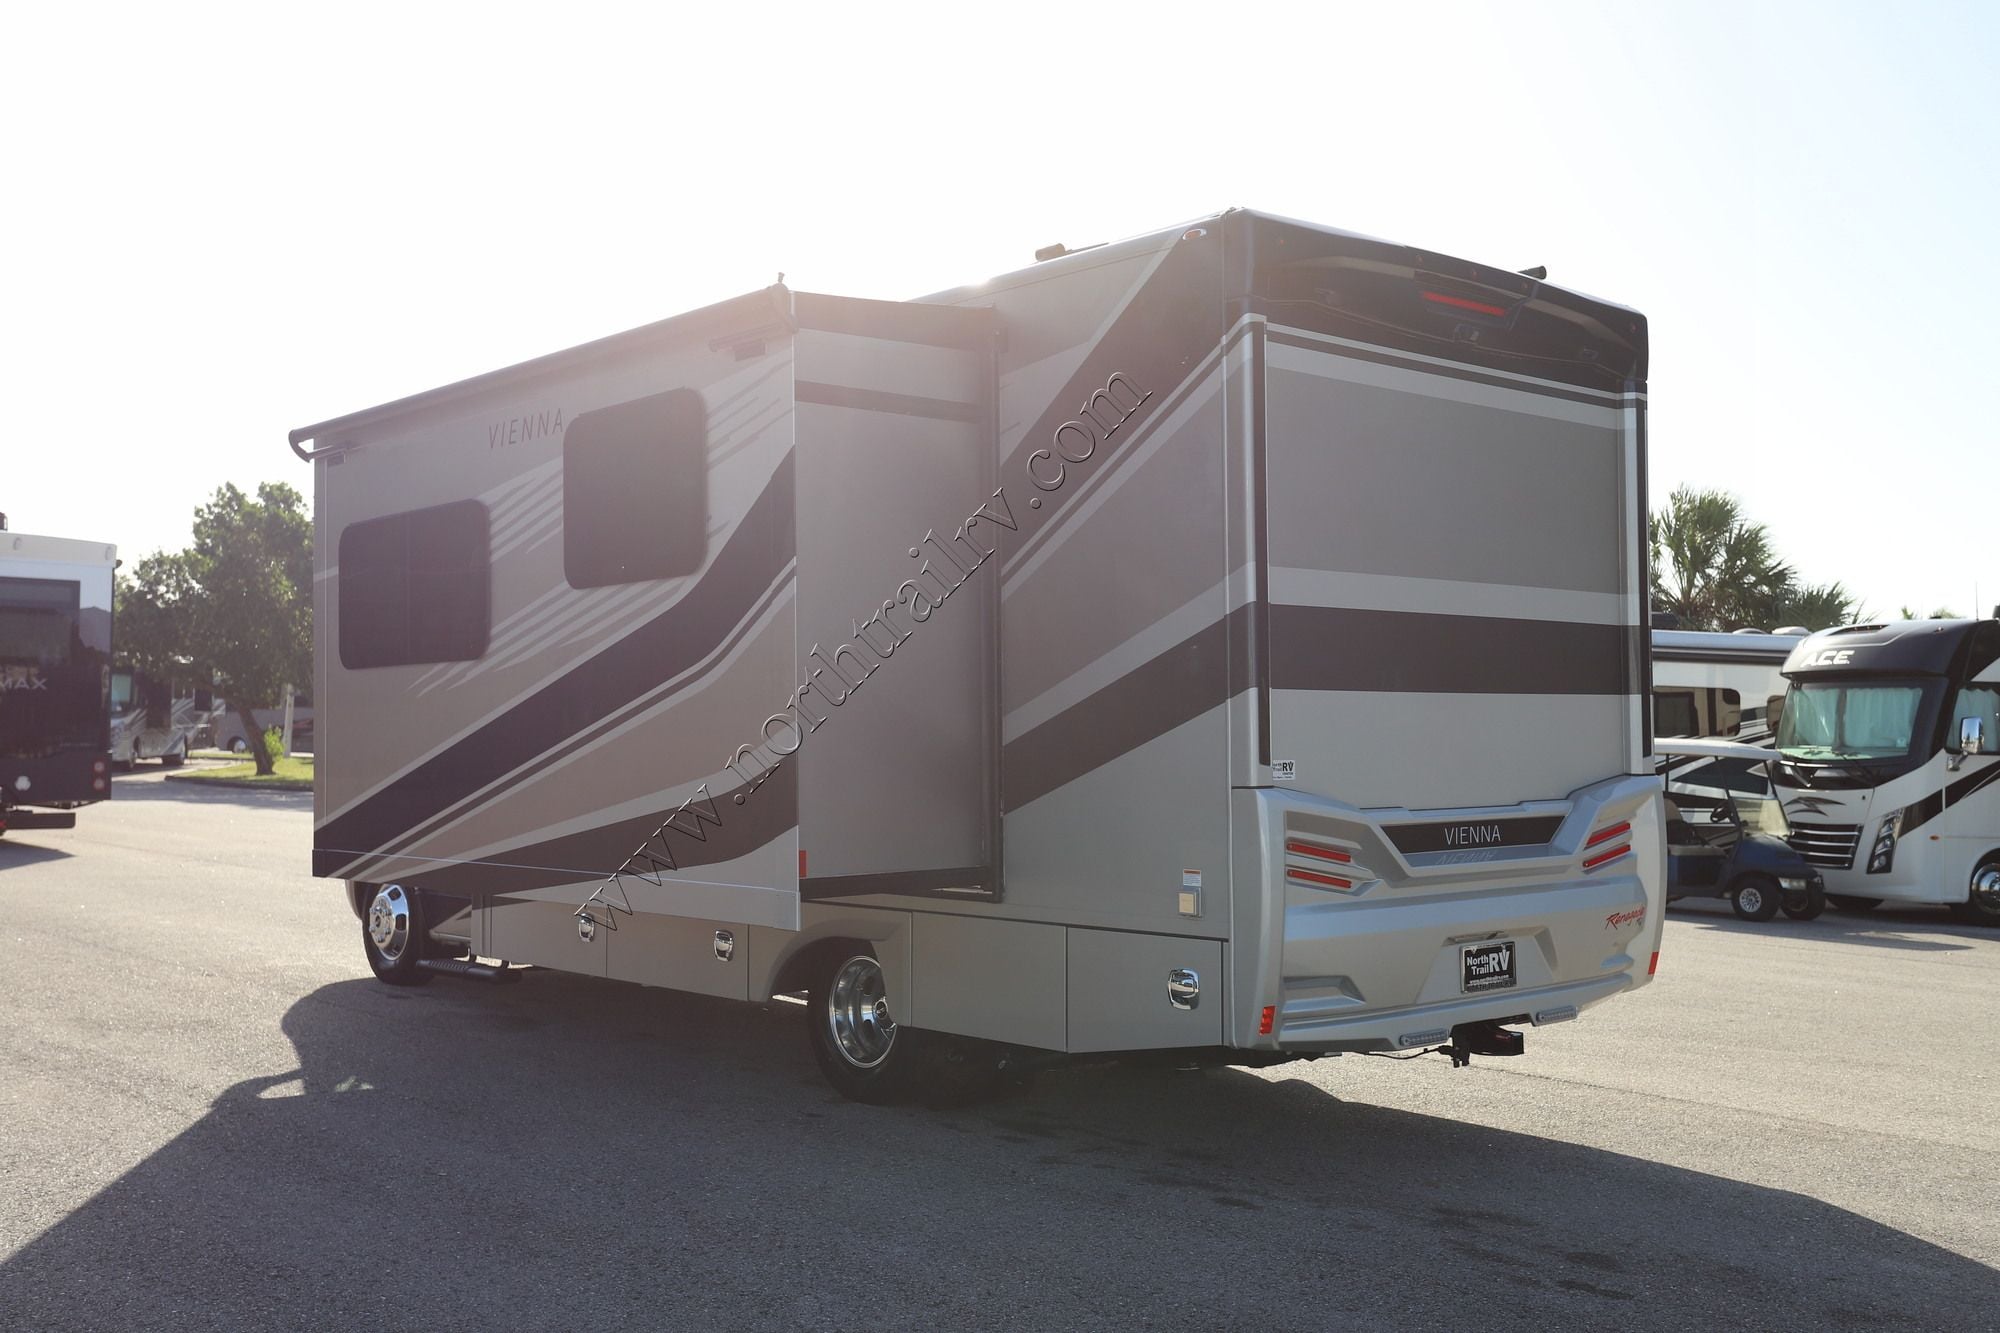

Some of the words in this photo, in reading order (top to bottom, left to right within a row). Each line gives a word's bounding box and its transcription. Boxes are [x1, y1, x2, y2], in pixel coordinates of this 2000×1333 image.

[488, 407, 563, 449] VIENNA
[1282, 761, 1294, 772] RV
[1444, 824, 1502, 846] VIENNA
[1466, 954, 1489, 966] North
[1489, 949, 1510, 973] RV
[1471, 963, 1489, 976] Trail
